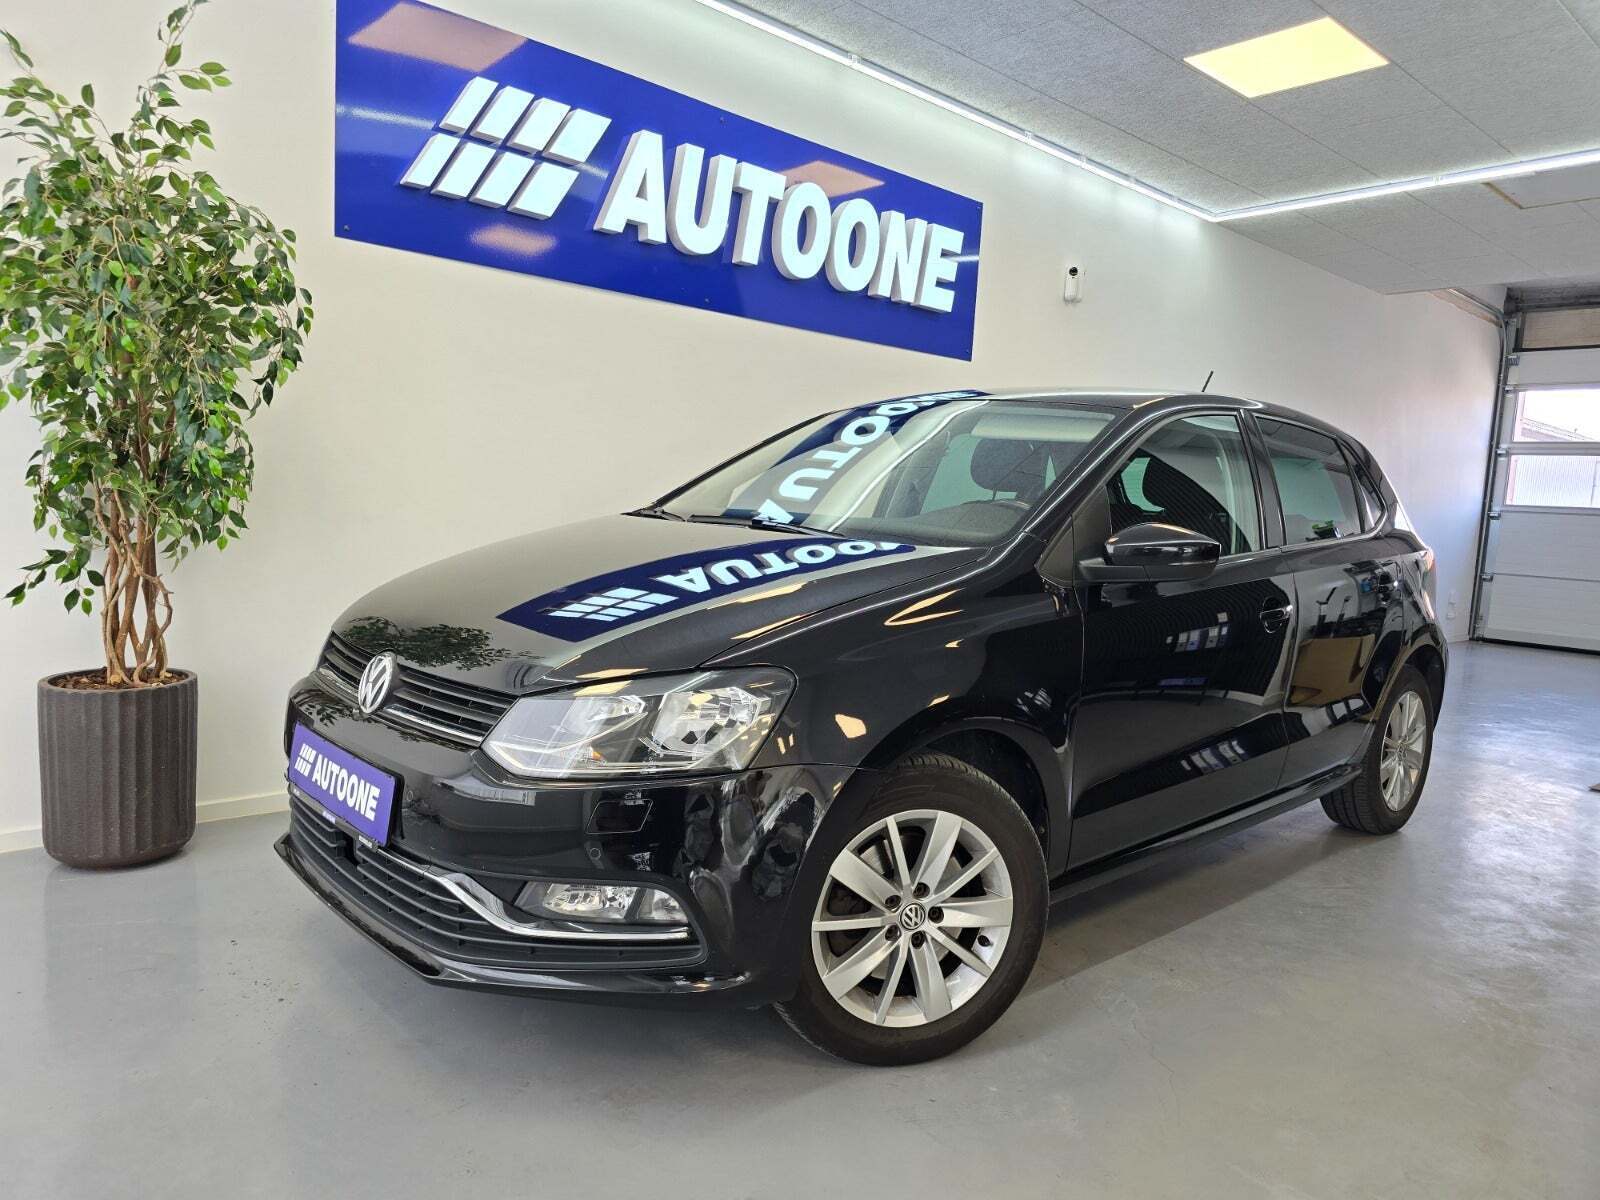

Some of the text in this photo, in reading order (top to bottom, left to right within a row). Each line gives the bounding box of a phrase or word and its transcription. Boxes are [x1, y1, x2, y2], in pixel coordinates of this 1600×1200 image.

[593, 129, 964, 313] AUTOONE
[358, 652, 393, 713] VW
[311, 754, 381, 822] AUTOONE
